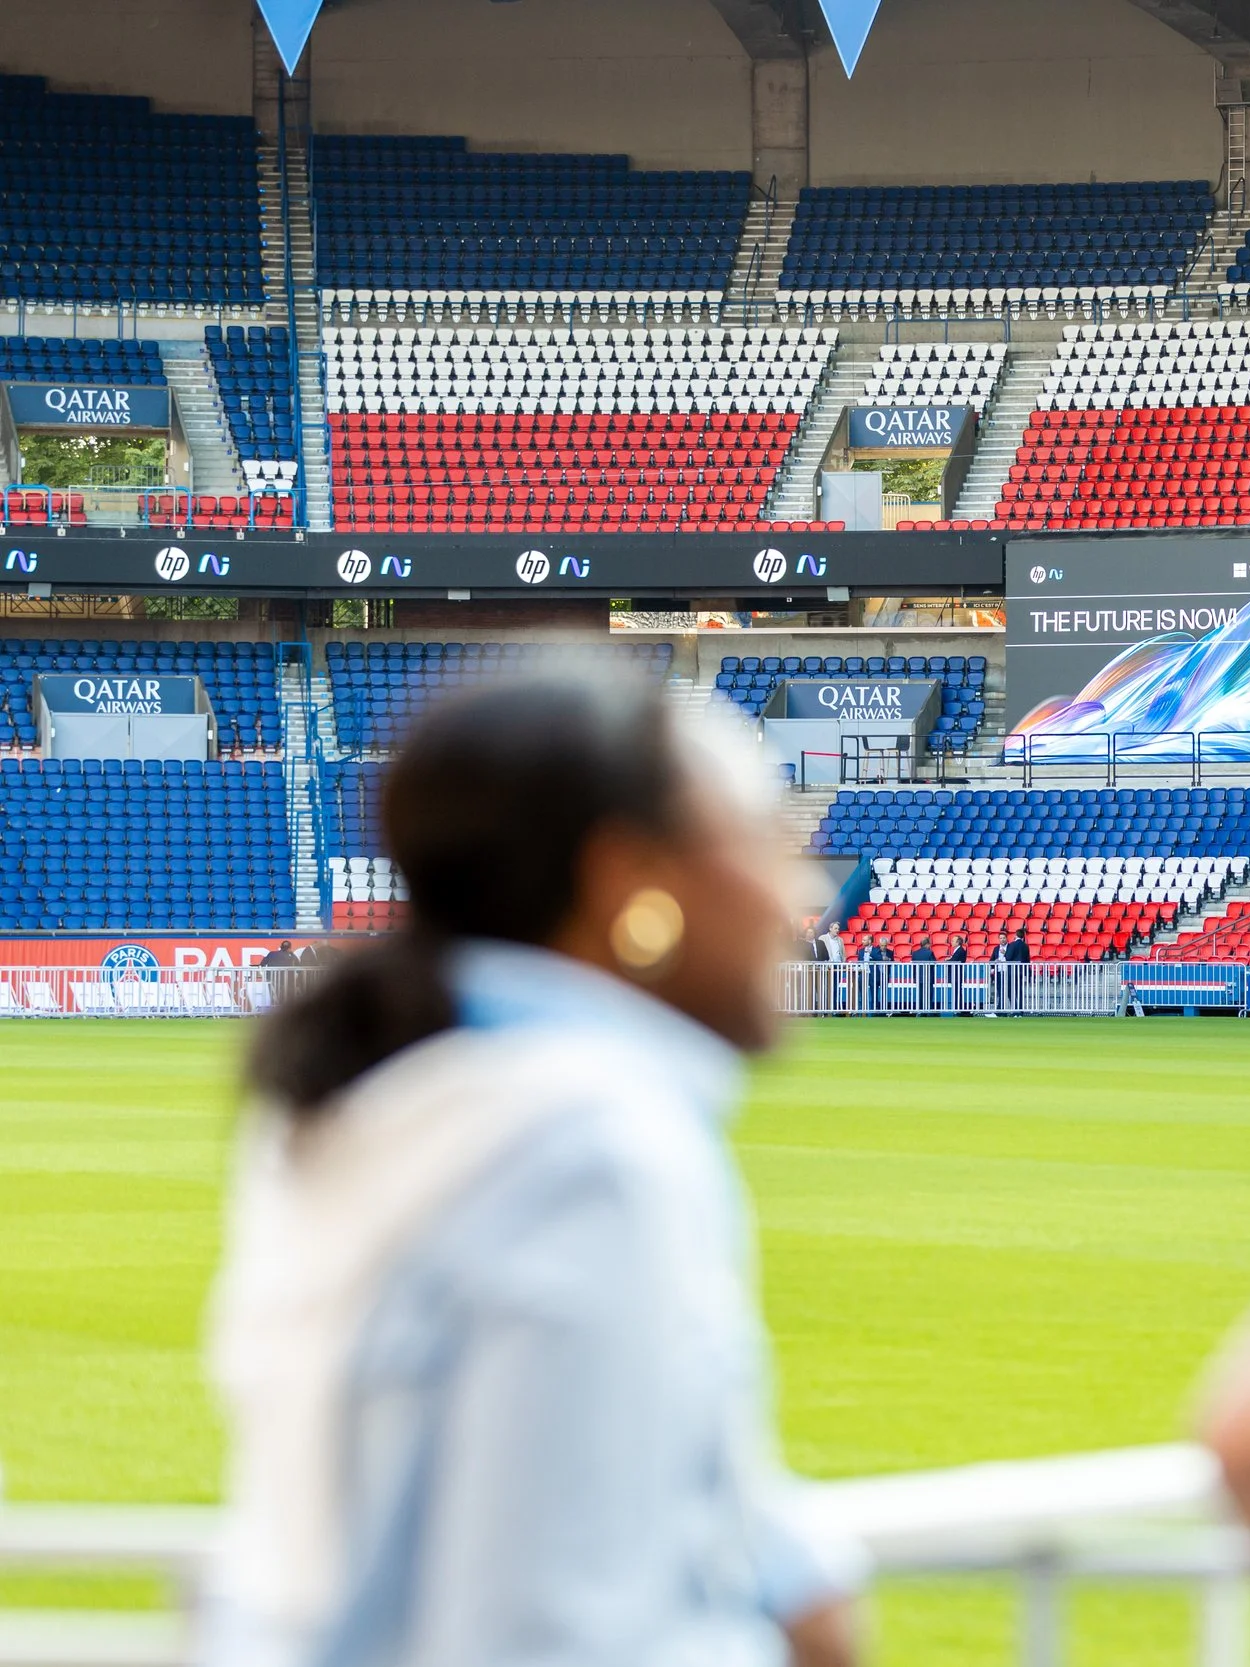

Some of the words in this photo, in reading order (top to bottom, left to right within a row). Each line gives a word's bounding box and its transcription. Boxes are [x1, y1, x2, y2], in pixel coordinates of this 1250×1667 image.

[45, 388, 131, 413] QATAR
[66, 410, 131, 424] AIRWAYS
[865, 410, 951, 436] QATAR
[886, 431, 952, 445] AIRWAYS
[158, 547, 187, 580] hp
[340, 550, 369, 583] hp
[519, 550, 547, 583] hp
[755, 549, 784, 582] hp
[1031, 566, 1046, 583] hp
[1031, 611, 1071, 632] THE
[1074, 609, 1153, 632] FUTURE
[1156, 609, 1175, 631] IS
[1180, 608, 1236, 630] NOW!
[74, 679, 161, 704] QATAR
[818, 686, 902, 710] QATAR
[96, 701, 161, 713] AIRWAYS
[839, 707, 902, 719] AIRWAYS
[110, 948, 149, 963] PARIS
